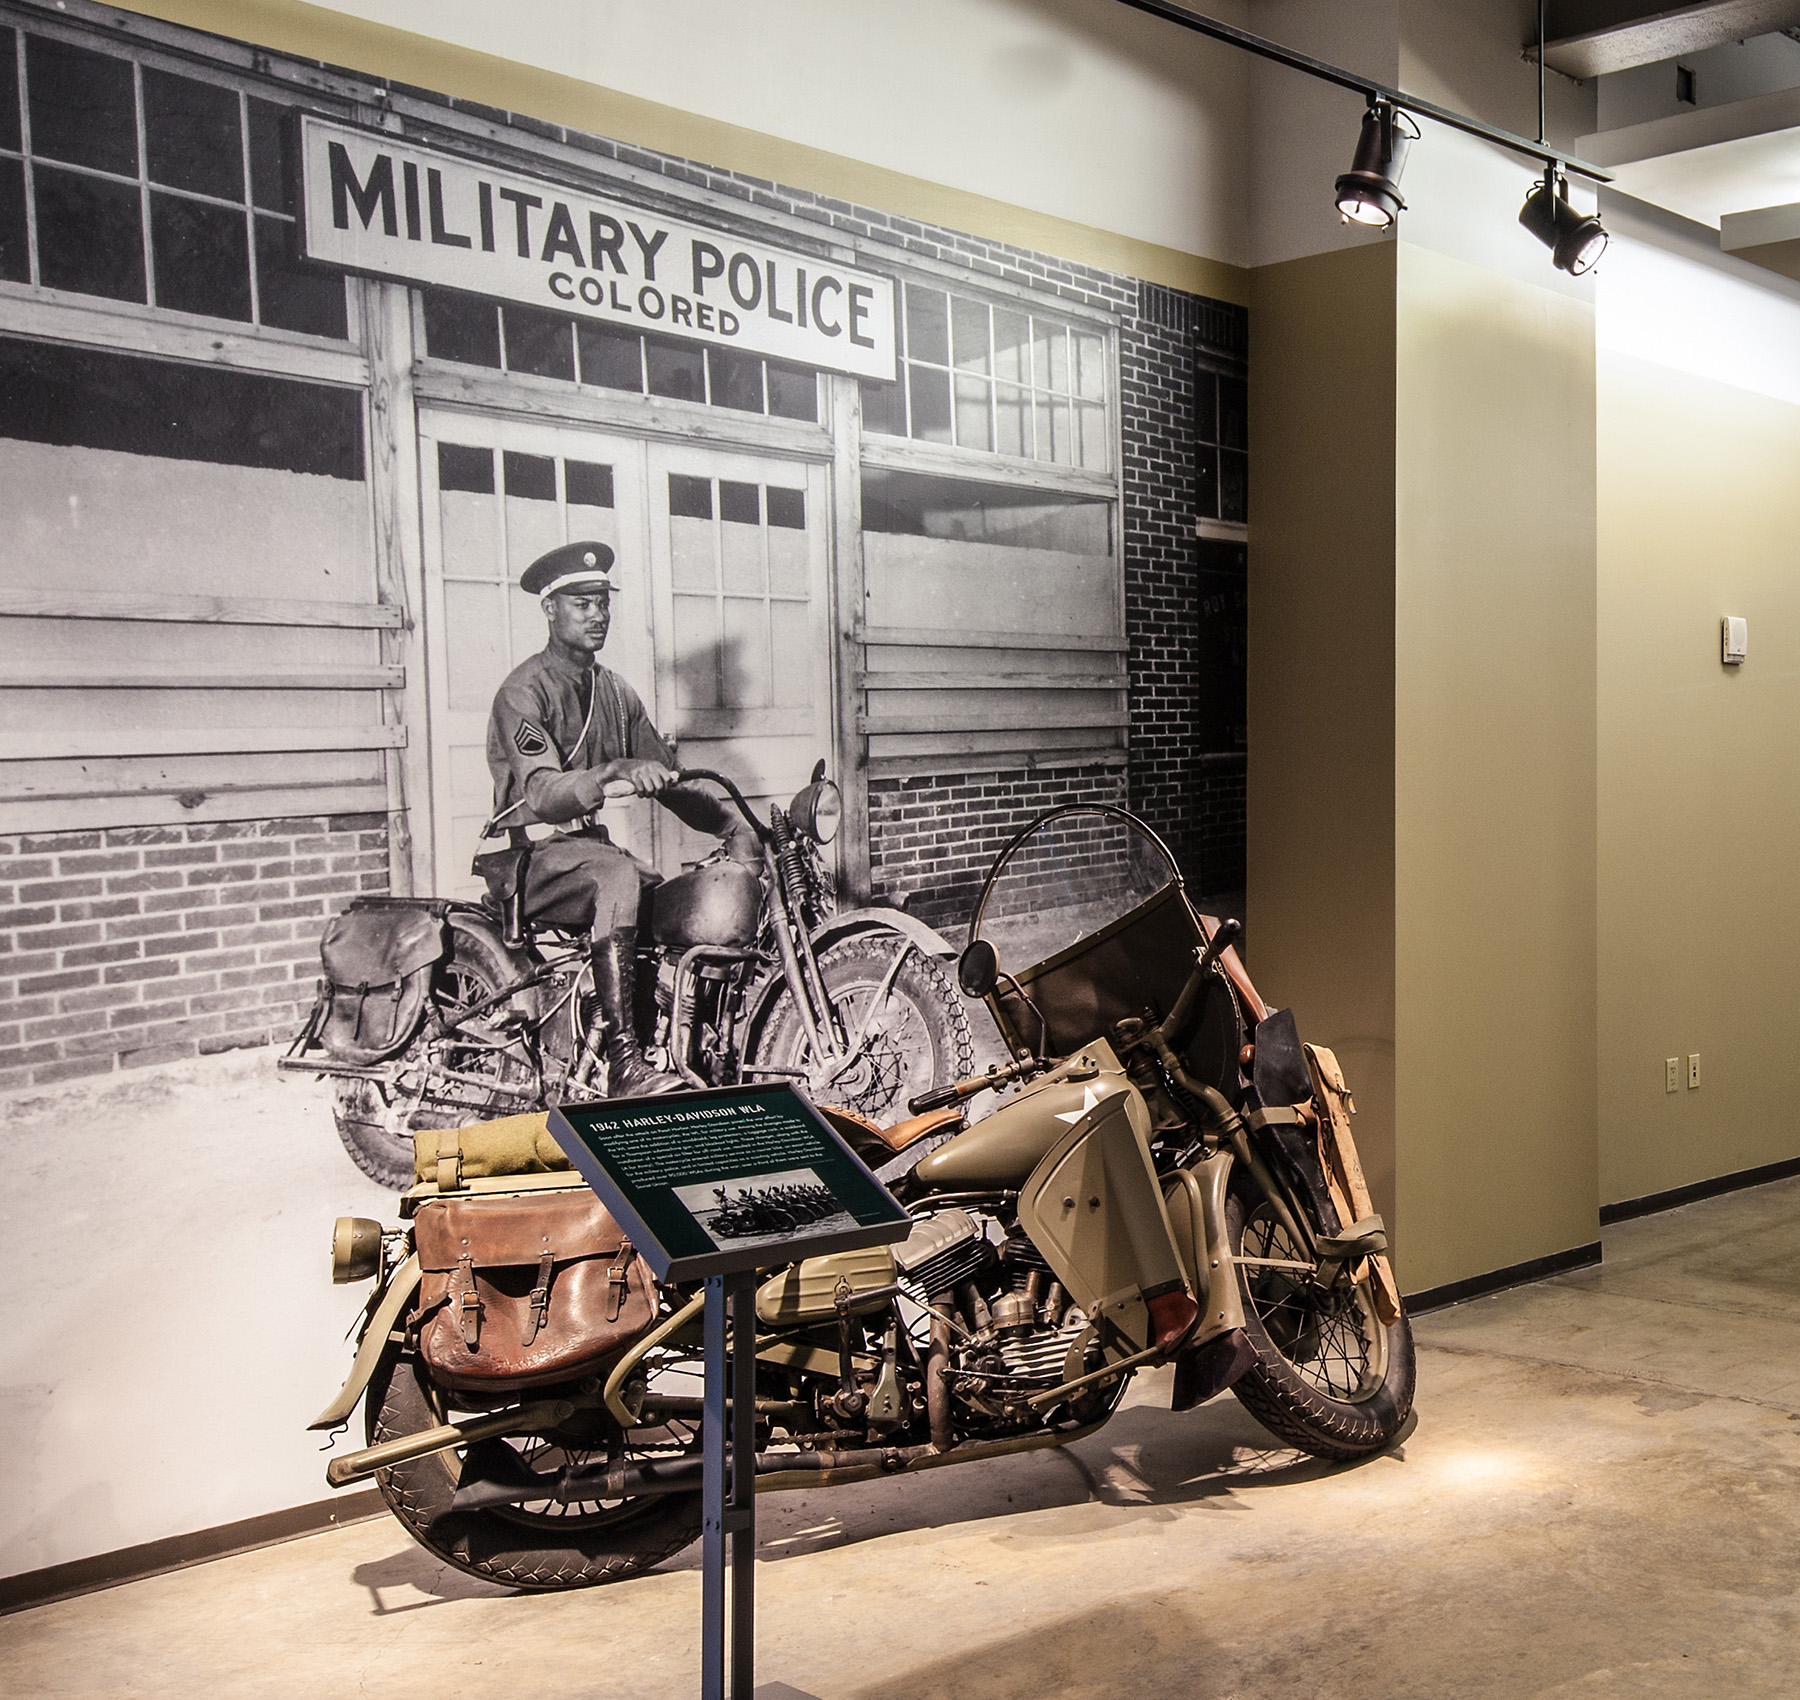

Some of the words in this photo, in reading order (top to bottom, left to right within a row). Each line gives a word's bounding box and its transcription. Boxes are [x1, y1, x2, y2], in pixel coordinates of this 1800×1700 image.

[328, 141, 668, 281] MILITARY
[692, 239, 874, 349] POLICE
[548, 271, 739, 336] COLORED
[589, 1119, 621, 1133] 1942
[622, 1107, 737, 1130] HARLEY-DAVIDSON
[738, 1104, 766, 1114] WLA
